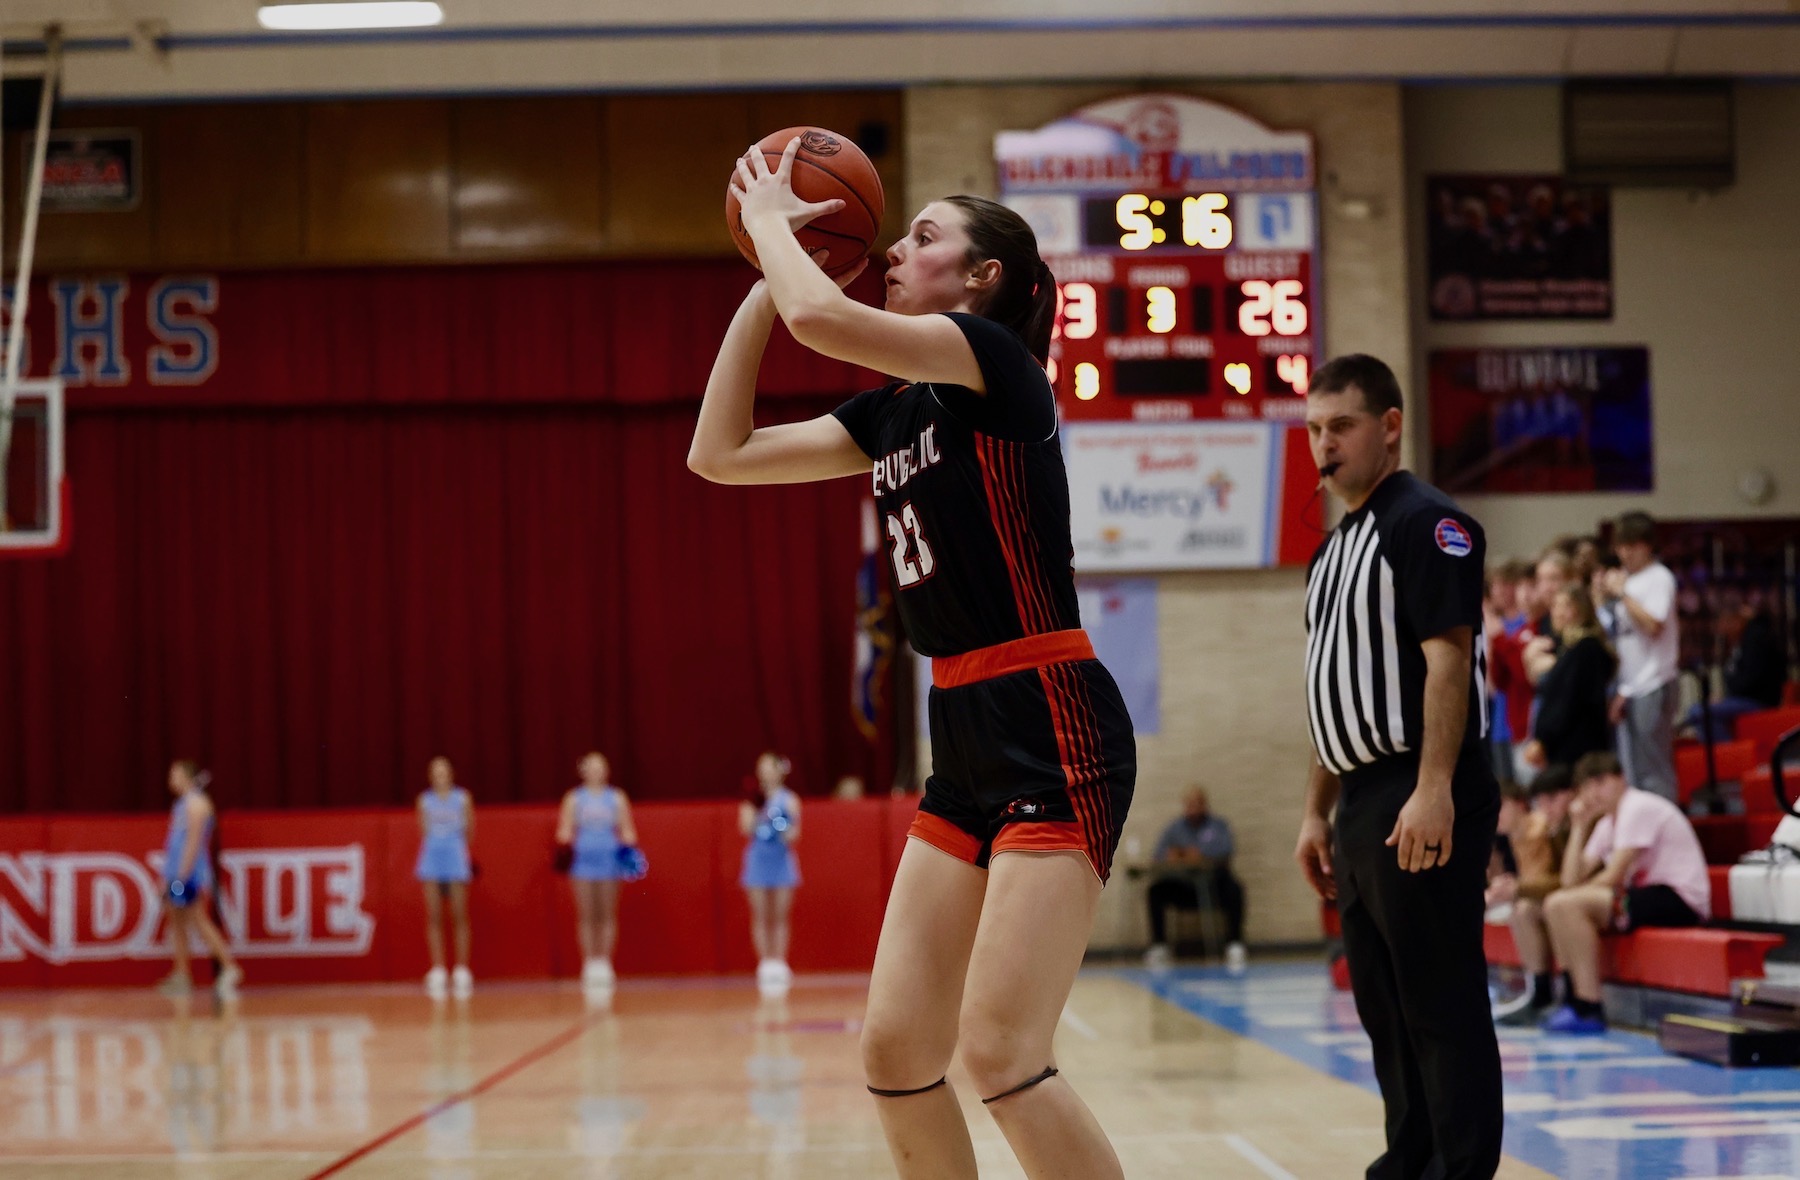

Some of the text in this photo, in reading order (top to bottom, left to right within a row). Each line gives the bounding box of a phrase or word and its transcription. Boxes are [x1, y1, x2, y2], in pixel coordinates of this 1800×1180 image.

[1116, 193, 1232, 250] 5:16
[1147, 286, 1176, 333] 3
[1238, 280, 1307, 336] 26
[1277, 354, 1308, 394] 4
[1100, 484, 1205, 519] Mercy
[886, 501, 937, 590] 23
[0, 843, 375, 966] NDLE
